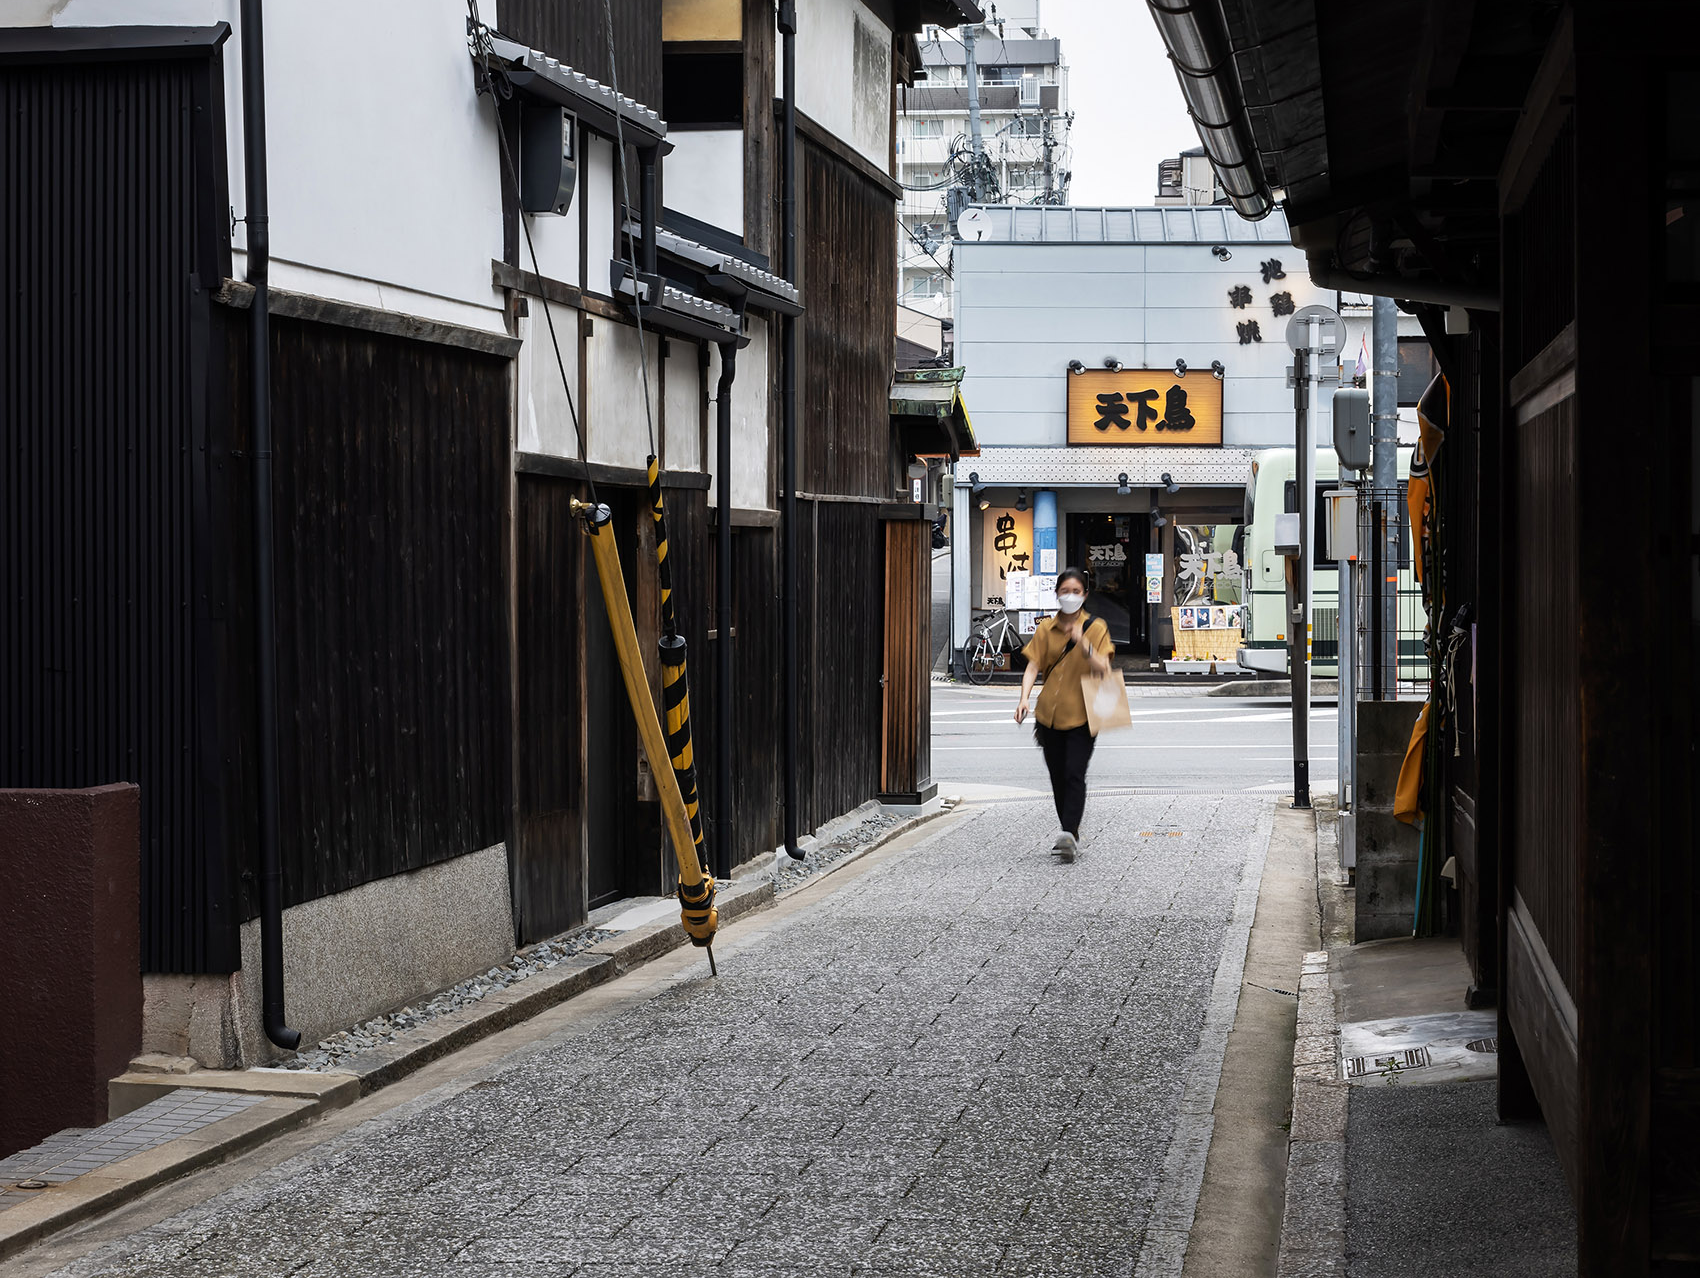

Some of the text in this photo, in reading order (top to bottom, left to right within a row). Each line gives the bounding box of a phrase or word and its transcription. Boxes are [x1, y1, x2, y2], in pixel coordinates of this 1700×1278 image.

[1094, 384, 1196, 432] 天下鳥
[1089, 543, 1127, 561] 天下鳥
